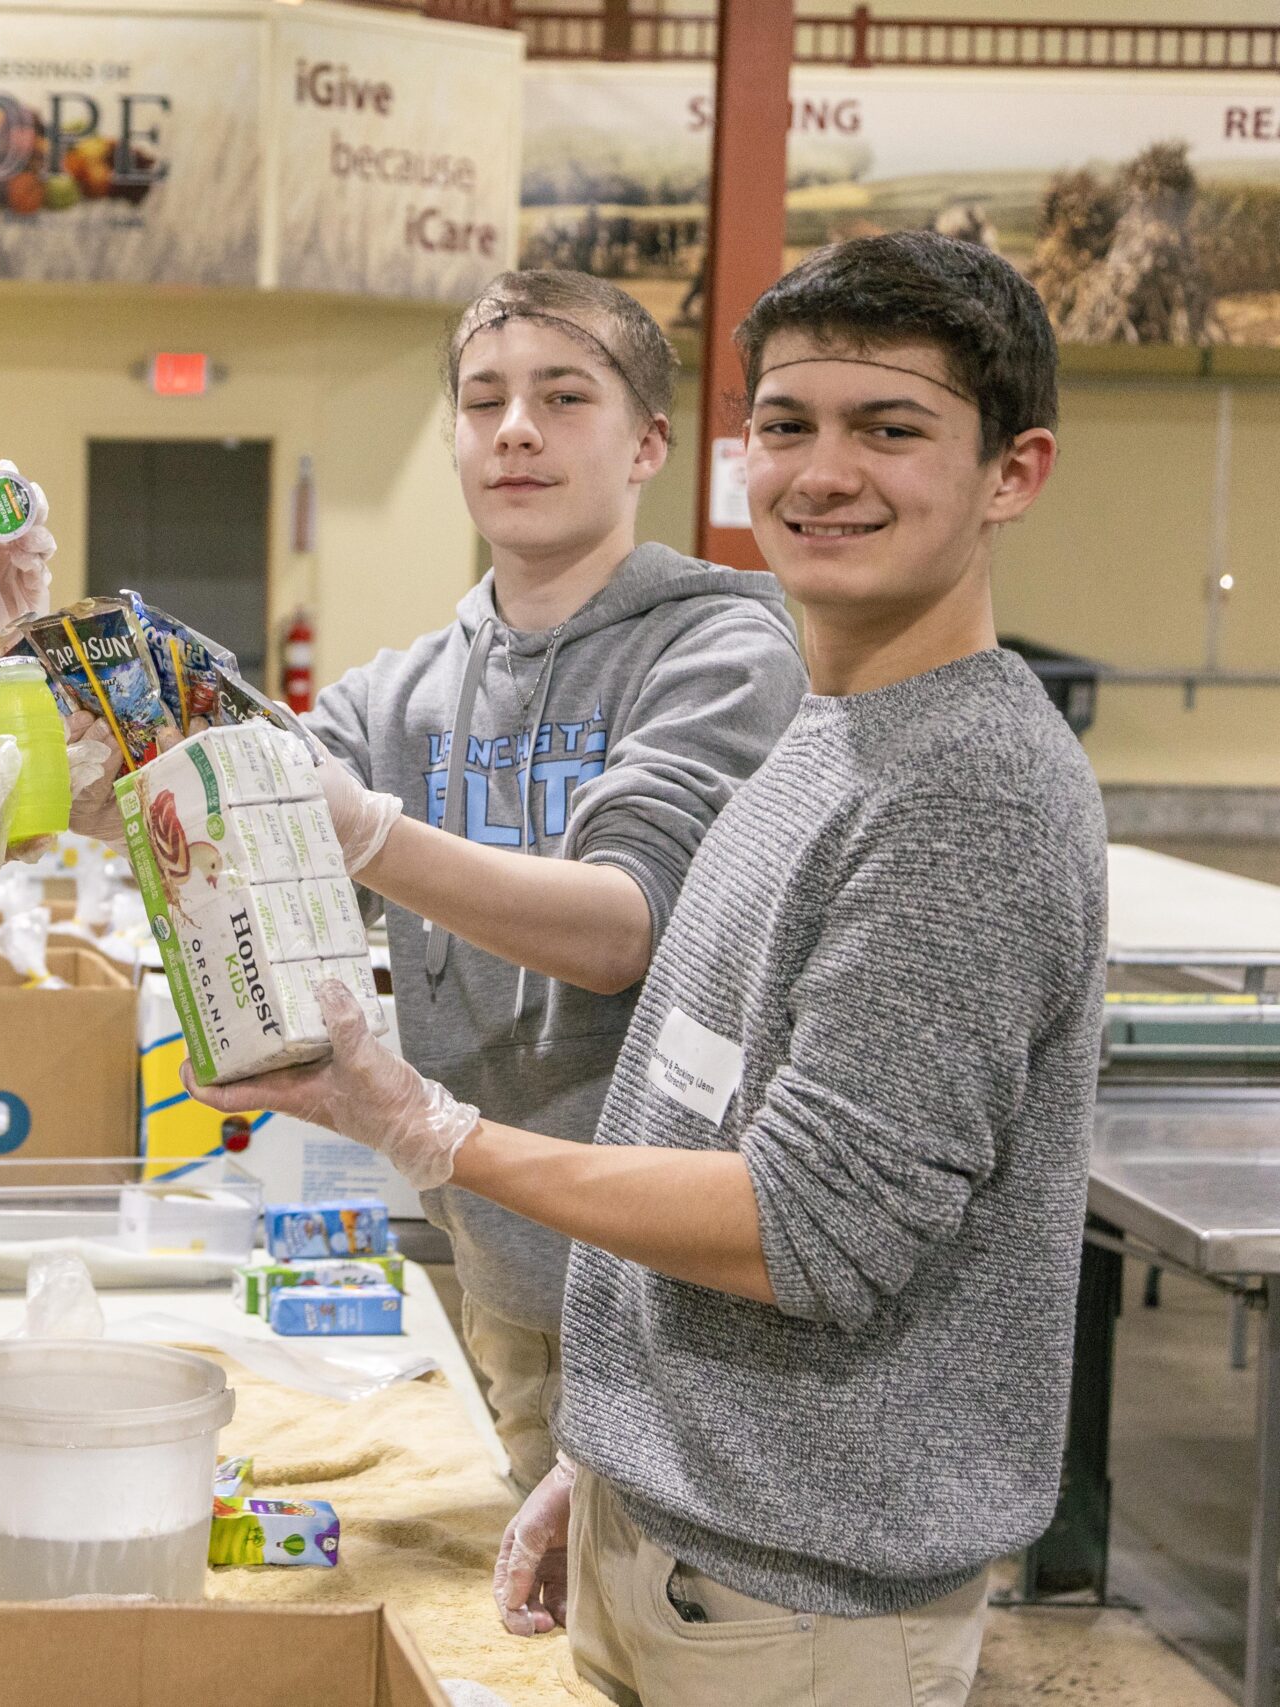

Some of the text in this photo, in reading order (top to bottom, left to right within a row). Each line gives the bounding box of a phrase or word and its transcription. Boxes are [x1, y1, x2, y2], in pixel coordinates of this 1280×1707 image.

[295, 58, 392, 117] iGive
[330, 130, 477, 194] because
[406, 204, 496, 258] iCare
[190, 938, 229, 1050] ORGANIC
[228, 907, 282, 1036] Honest
[177, 992, 190, 1014] FROM
